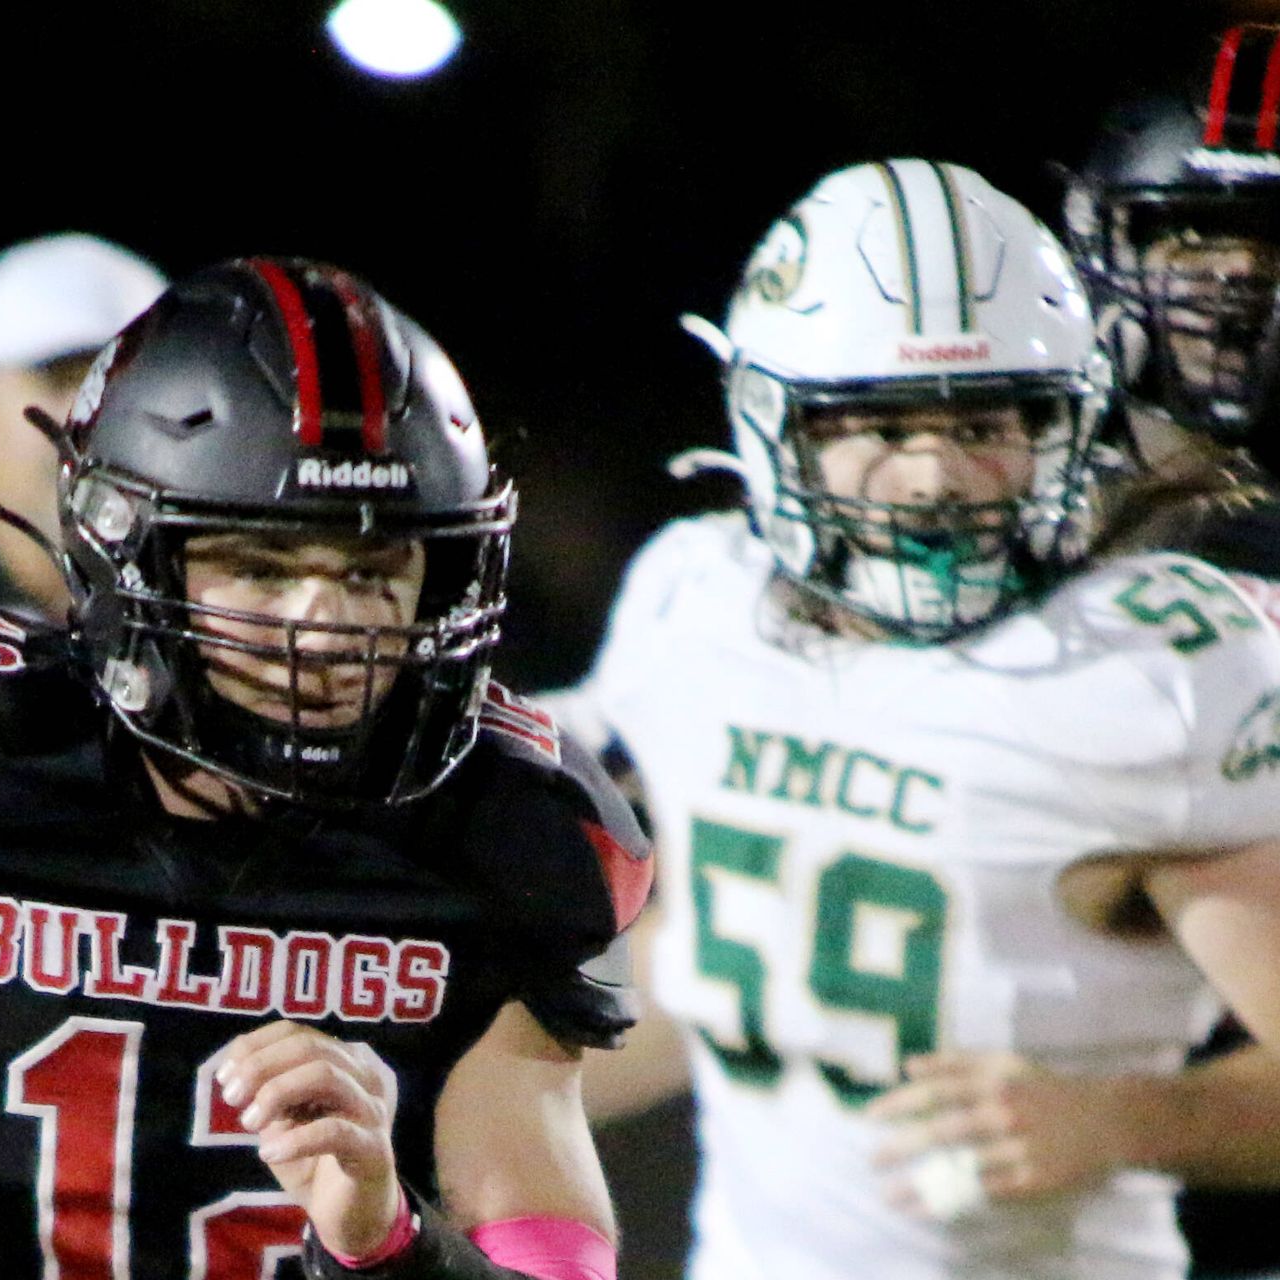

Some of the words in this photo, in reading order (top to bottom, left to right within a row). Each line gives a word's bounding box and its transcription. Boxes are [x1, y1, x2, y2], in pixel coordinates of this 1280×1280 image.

[298, 458, 408, 488] Riddell
[719, 722, 945, 836] NMCC
[686, 813, 952, 1115] 59
